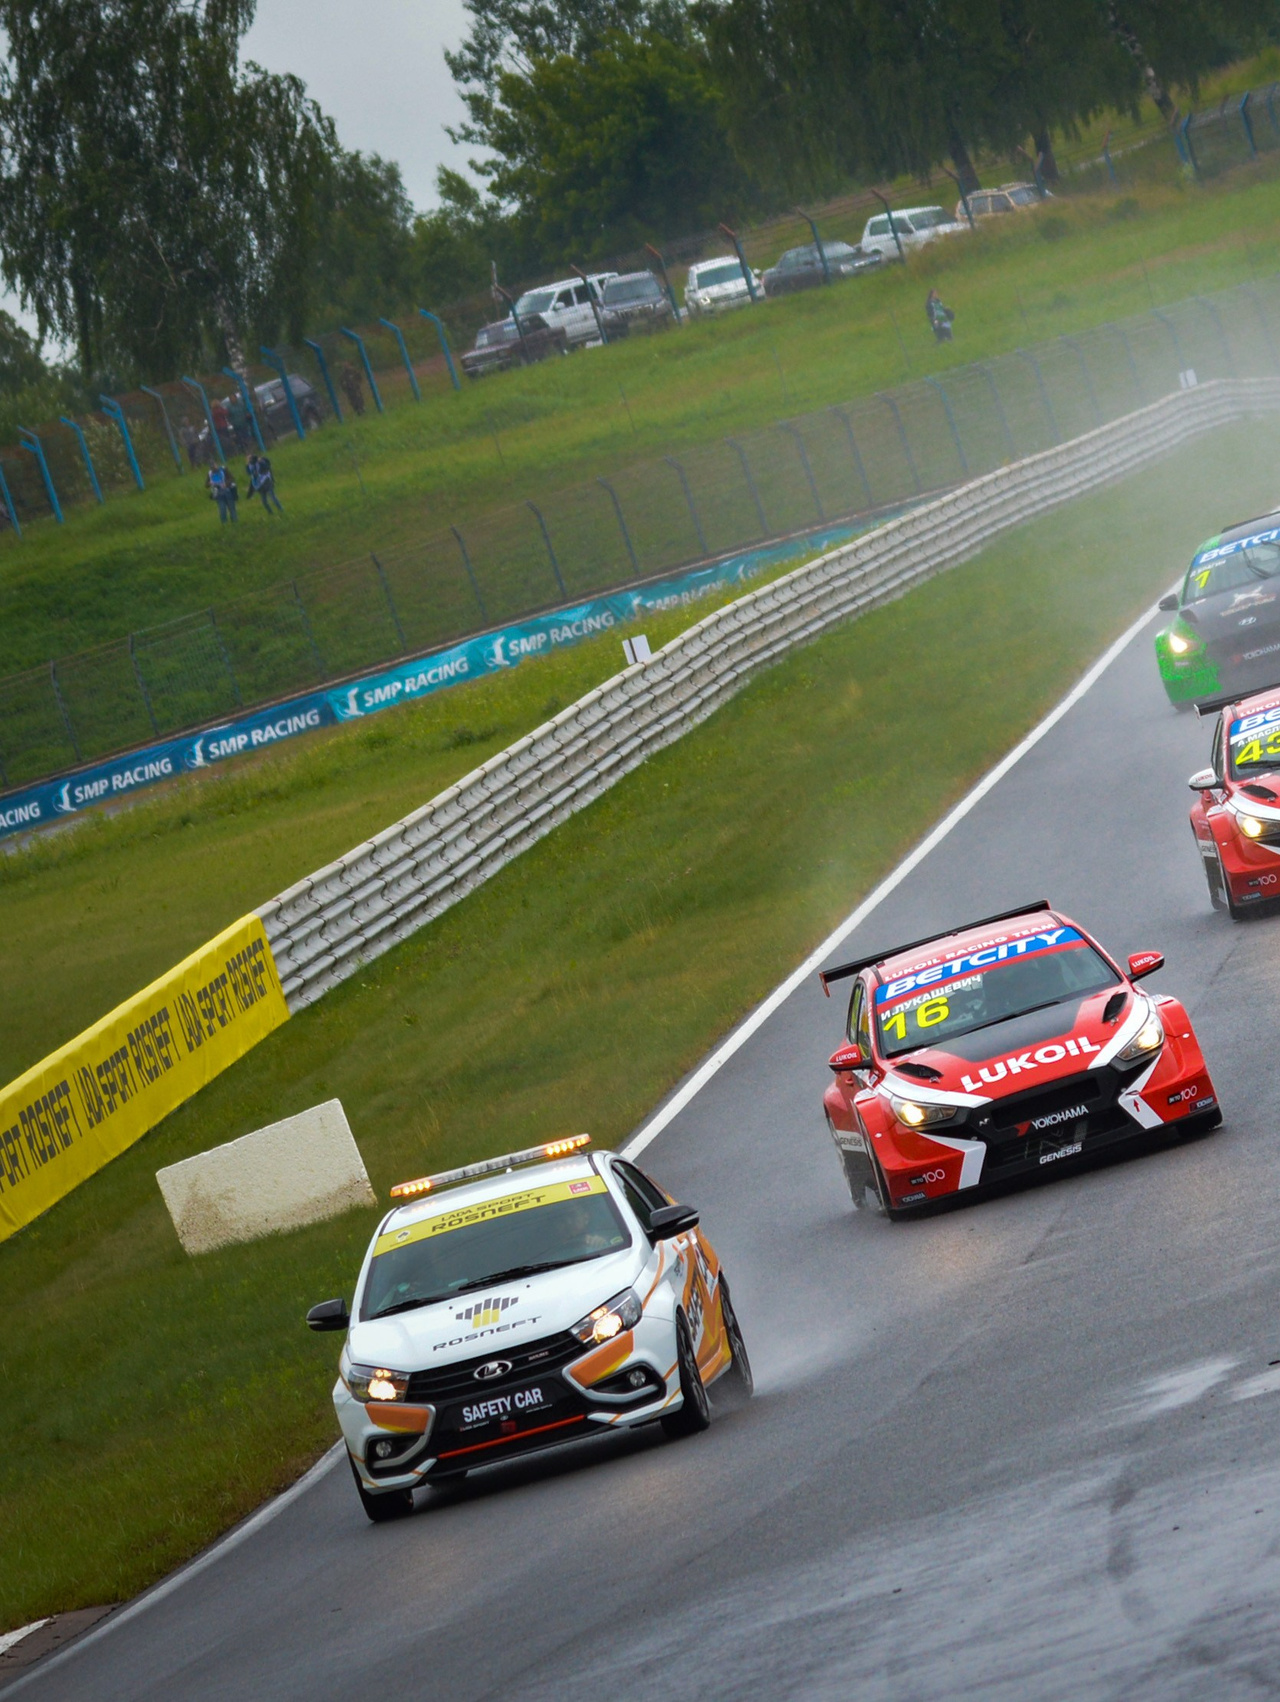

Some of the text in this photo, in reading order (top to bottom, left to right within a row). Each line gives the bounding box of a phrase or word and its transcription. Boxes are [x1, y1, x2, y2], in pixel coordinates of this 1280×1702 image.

[1194, 568, 1211, 589] 1
[508, 610, 616, 657] SMP RACING
[363, 656, 470, 707] SMP RACING
[208, 709, 320, 760] SMP RACING
[74, 757, 173, 804] SMP RACING
[884, 923, 1056, 982] LUKOIL RACING TEAM
[885, 928, 1066, 1000] BETCITY
[1132, 955, 1155, 968] LUKOIL
[196, 972, 236, 1038] SPORT
[225, 937, 276, 1014] ROSNEFT
[880, 973, 982, 1022] И.ЛУКАШЕВИЧ
[882, 996, 950, 1040] 16
[96, 1045, 139, 1115] SPORT
[127, 1006, 182, 1089] ROSNEFT
[835, 1052, 858, 1063] LUKOIL
[960, 1036, 1101, 1093] LUKOIL
[1180, 1085, 1198, 1101] 100
[18, 1079, 83, 1170] ROSNEFT
[1031, 1104, 1090, 1131] YOKOHAMA
[839, 1136, 863, 1148] GENESIS
[1039, 1142, 1083, 1165] GENESIS
[922, 1168, 946, 1184] 100
[430, 1194, 547, 1233] ROSNEFT
[440, 1192, 535, 1222] LADA SPORT
[433, 1315, 542, 1352] ROSNEFT
[462, 1395, 512, 1423] SAFETY
[514, 1387, 544, 1409] CAR
